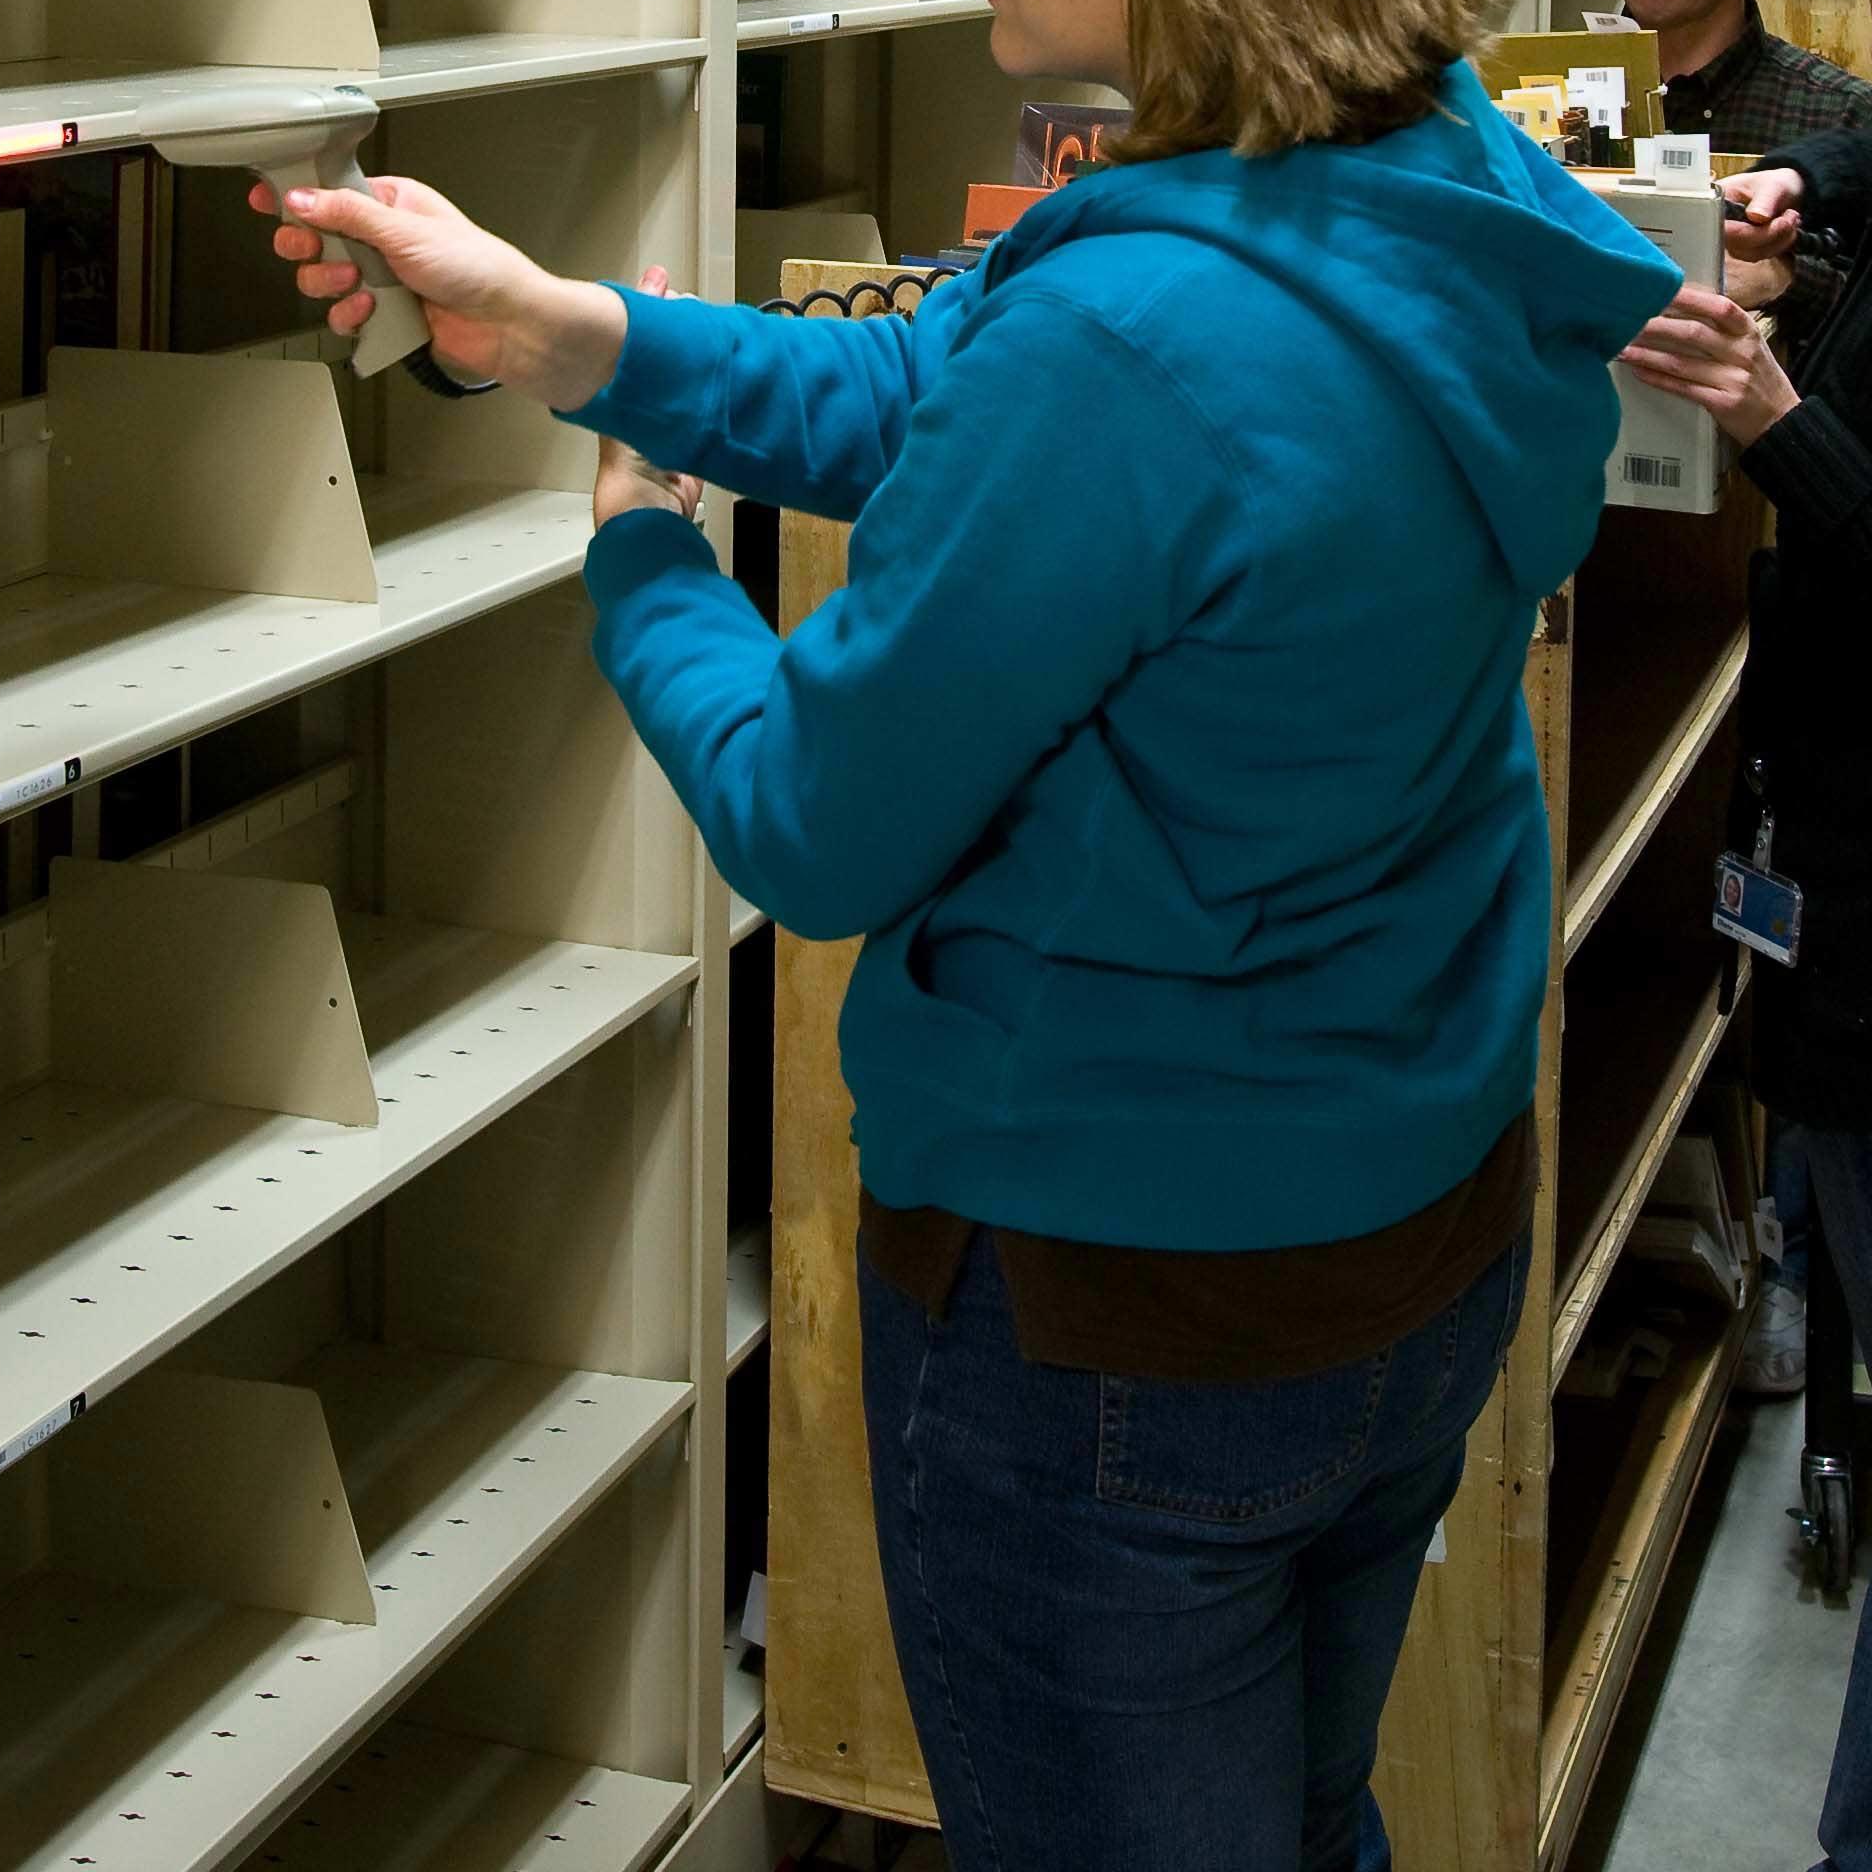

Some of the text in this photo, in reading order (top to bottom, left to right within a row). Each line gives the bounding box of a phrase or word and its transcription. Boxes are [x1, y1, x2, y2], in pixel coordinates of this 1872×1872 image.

[64, 127, 74, 143] 5
[68, 764, 75, 779] 6
[73, 1400, 81, 1415] 7
